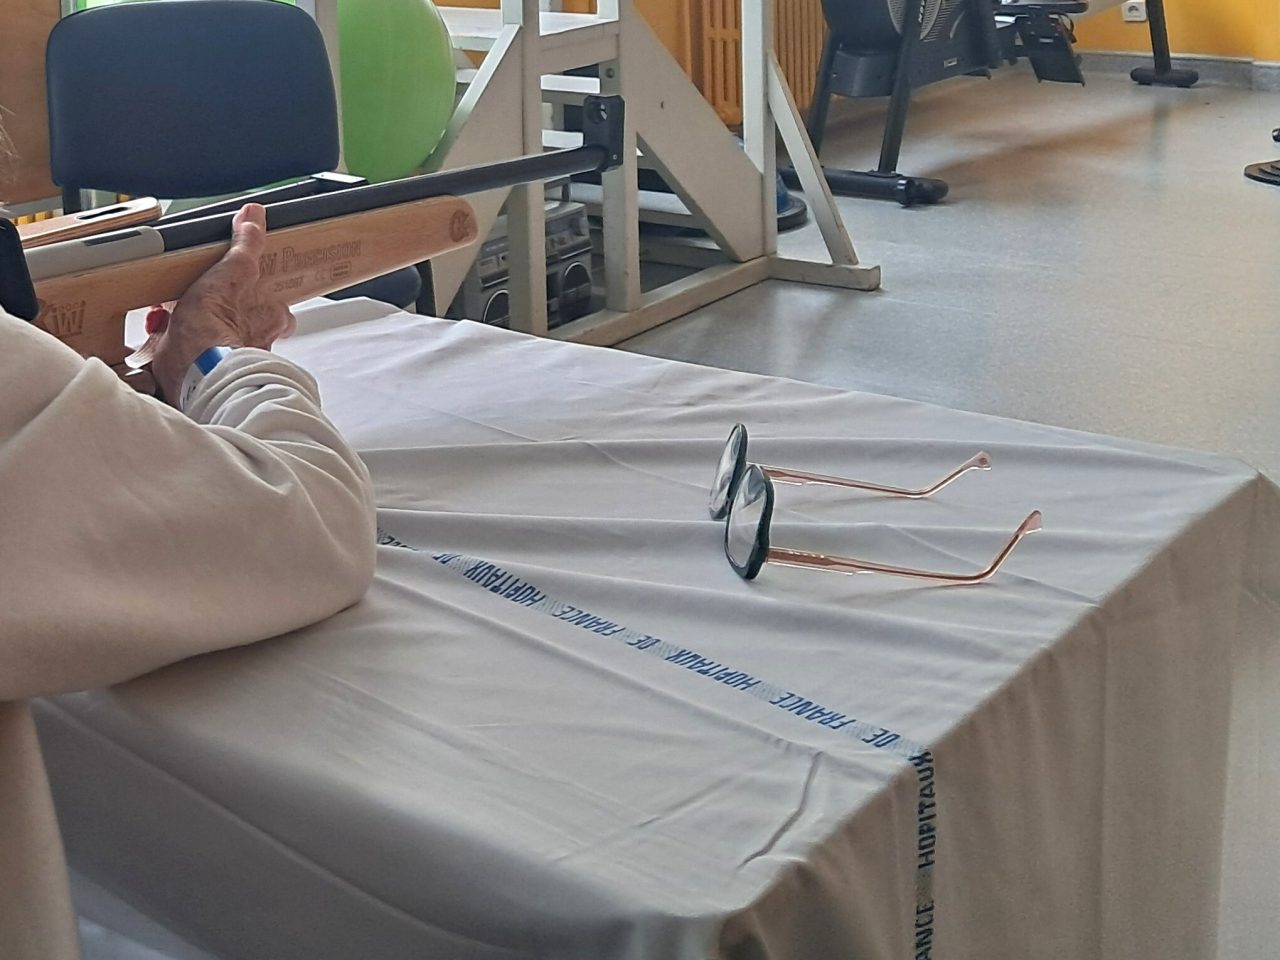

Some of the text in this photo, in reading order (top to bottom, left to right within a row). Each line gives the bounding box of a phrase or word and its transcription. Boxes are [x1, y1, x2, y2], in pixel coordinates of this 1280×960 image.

[463, 560, 547, 607] HOPITAUX
[552, 605, 625, 637] FRANCE
[627, 634, 661, 650] DE
[664, 648, 762, 691] HOPITAUX
[769, 691, 857, 730] FRANCE
[861, 727, 901, 748] DE
[908, 750, 937, 869] HOPITAUX
